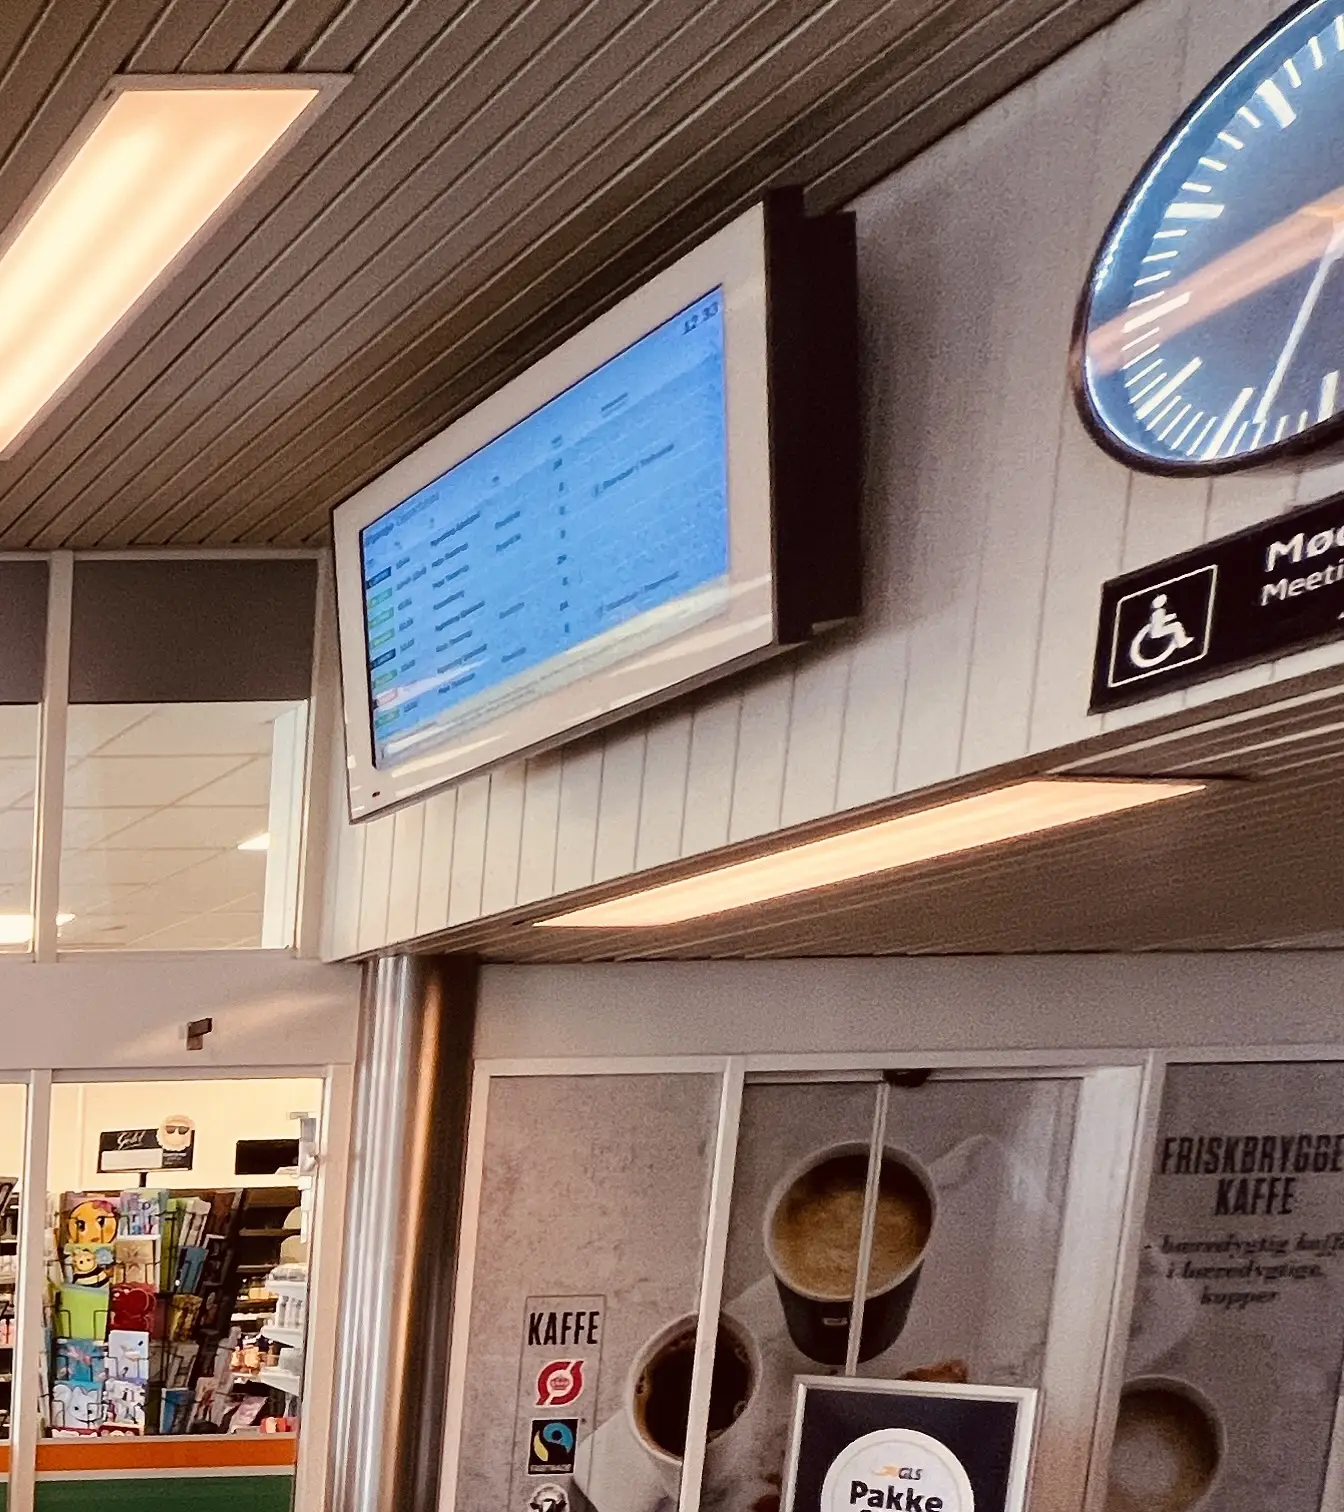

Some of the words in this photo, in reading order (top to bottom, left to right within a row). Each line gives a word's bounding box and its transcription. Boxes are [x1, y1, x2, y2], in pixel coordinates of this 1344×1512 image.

[1214, 1176, 1296, 1216] KAFFE
[527, 1310, 600, 1346] KAFFE
[898, 1467, 923, 1481] GLS
